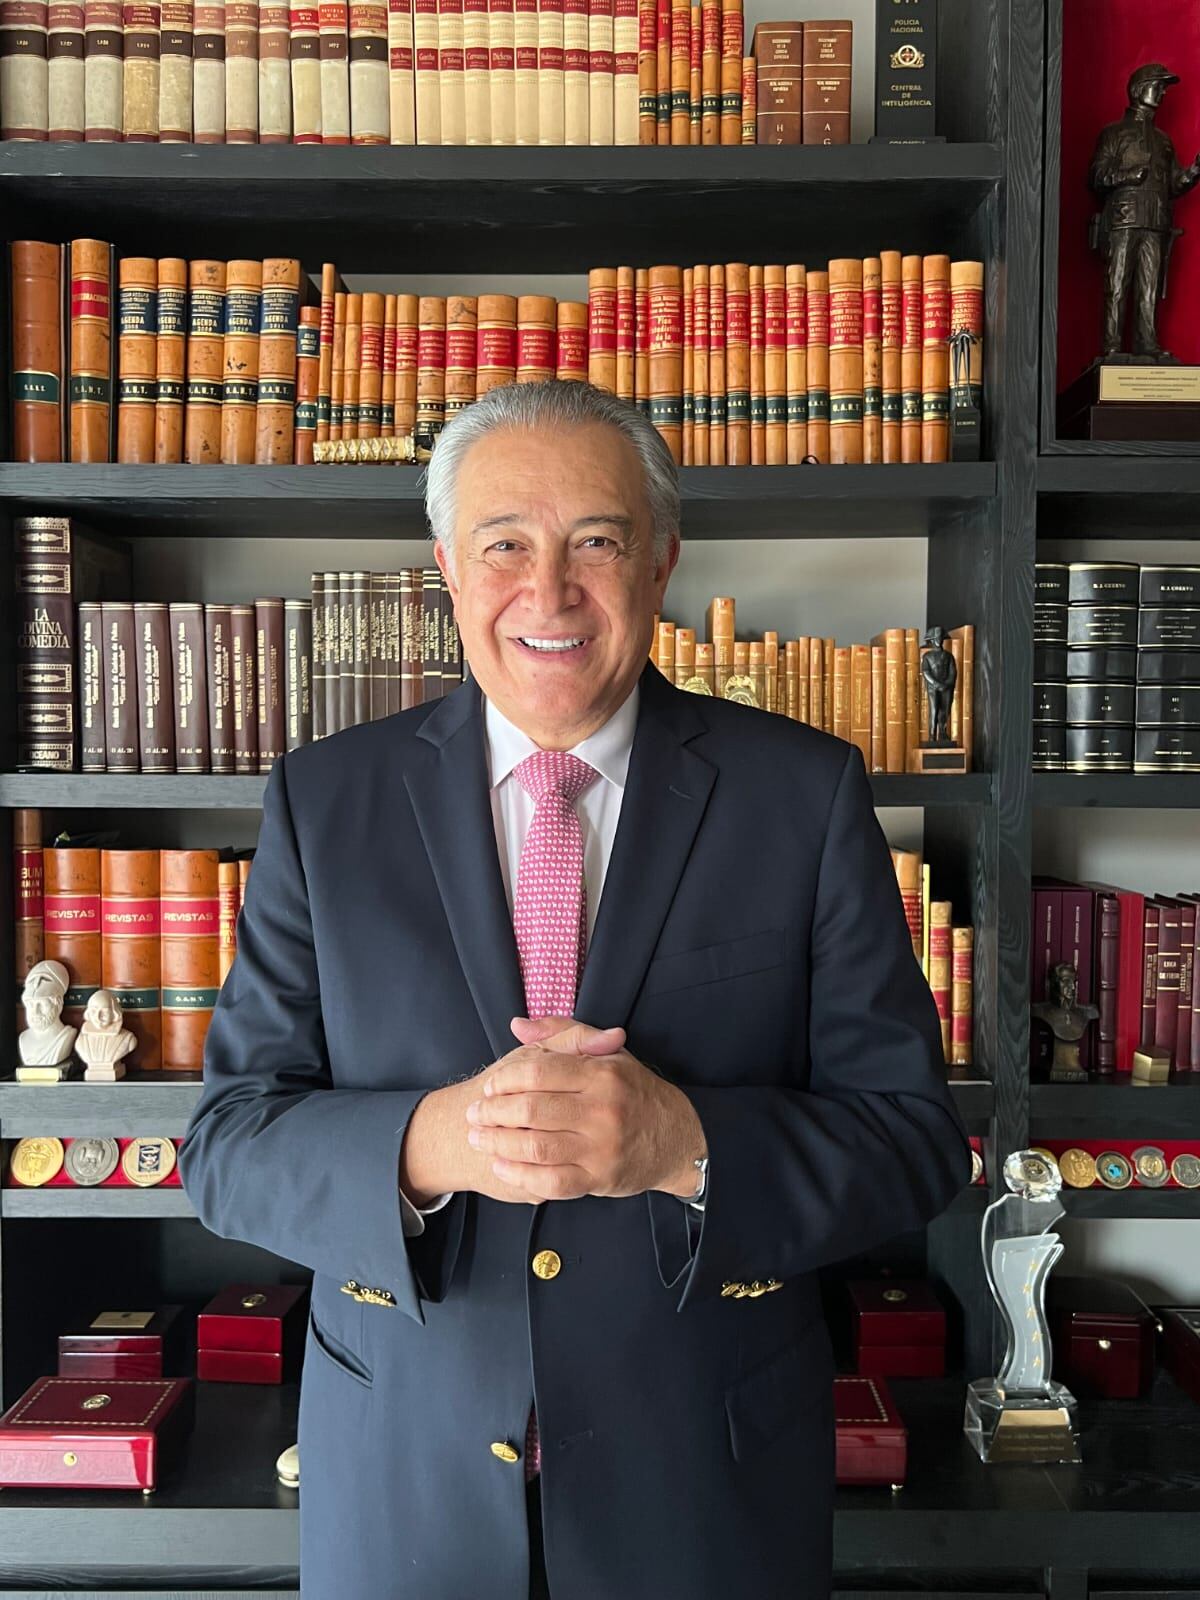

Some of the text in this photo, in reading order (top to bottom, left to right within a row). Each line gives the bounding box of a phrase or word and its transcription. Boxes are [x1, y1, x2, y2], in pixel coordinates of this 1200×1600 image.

[777, 124, 784, 132] H
[192, 318, 218, 327] AGENDA
[228, 318, 252, 326] AGENDA
[264, 315, 288, 324] AGENDA
[34, 608, 50, 621] LA
[24, 621, 64, 634] DIVINA
[18, 634, 71, 649] COMEDIA
[47, 910, 95, 918] REVISTAS
[104, 914, 153, 922] REVISTAS
[164, 912, 213, 921] REVISTAS
